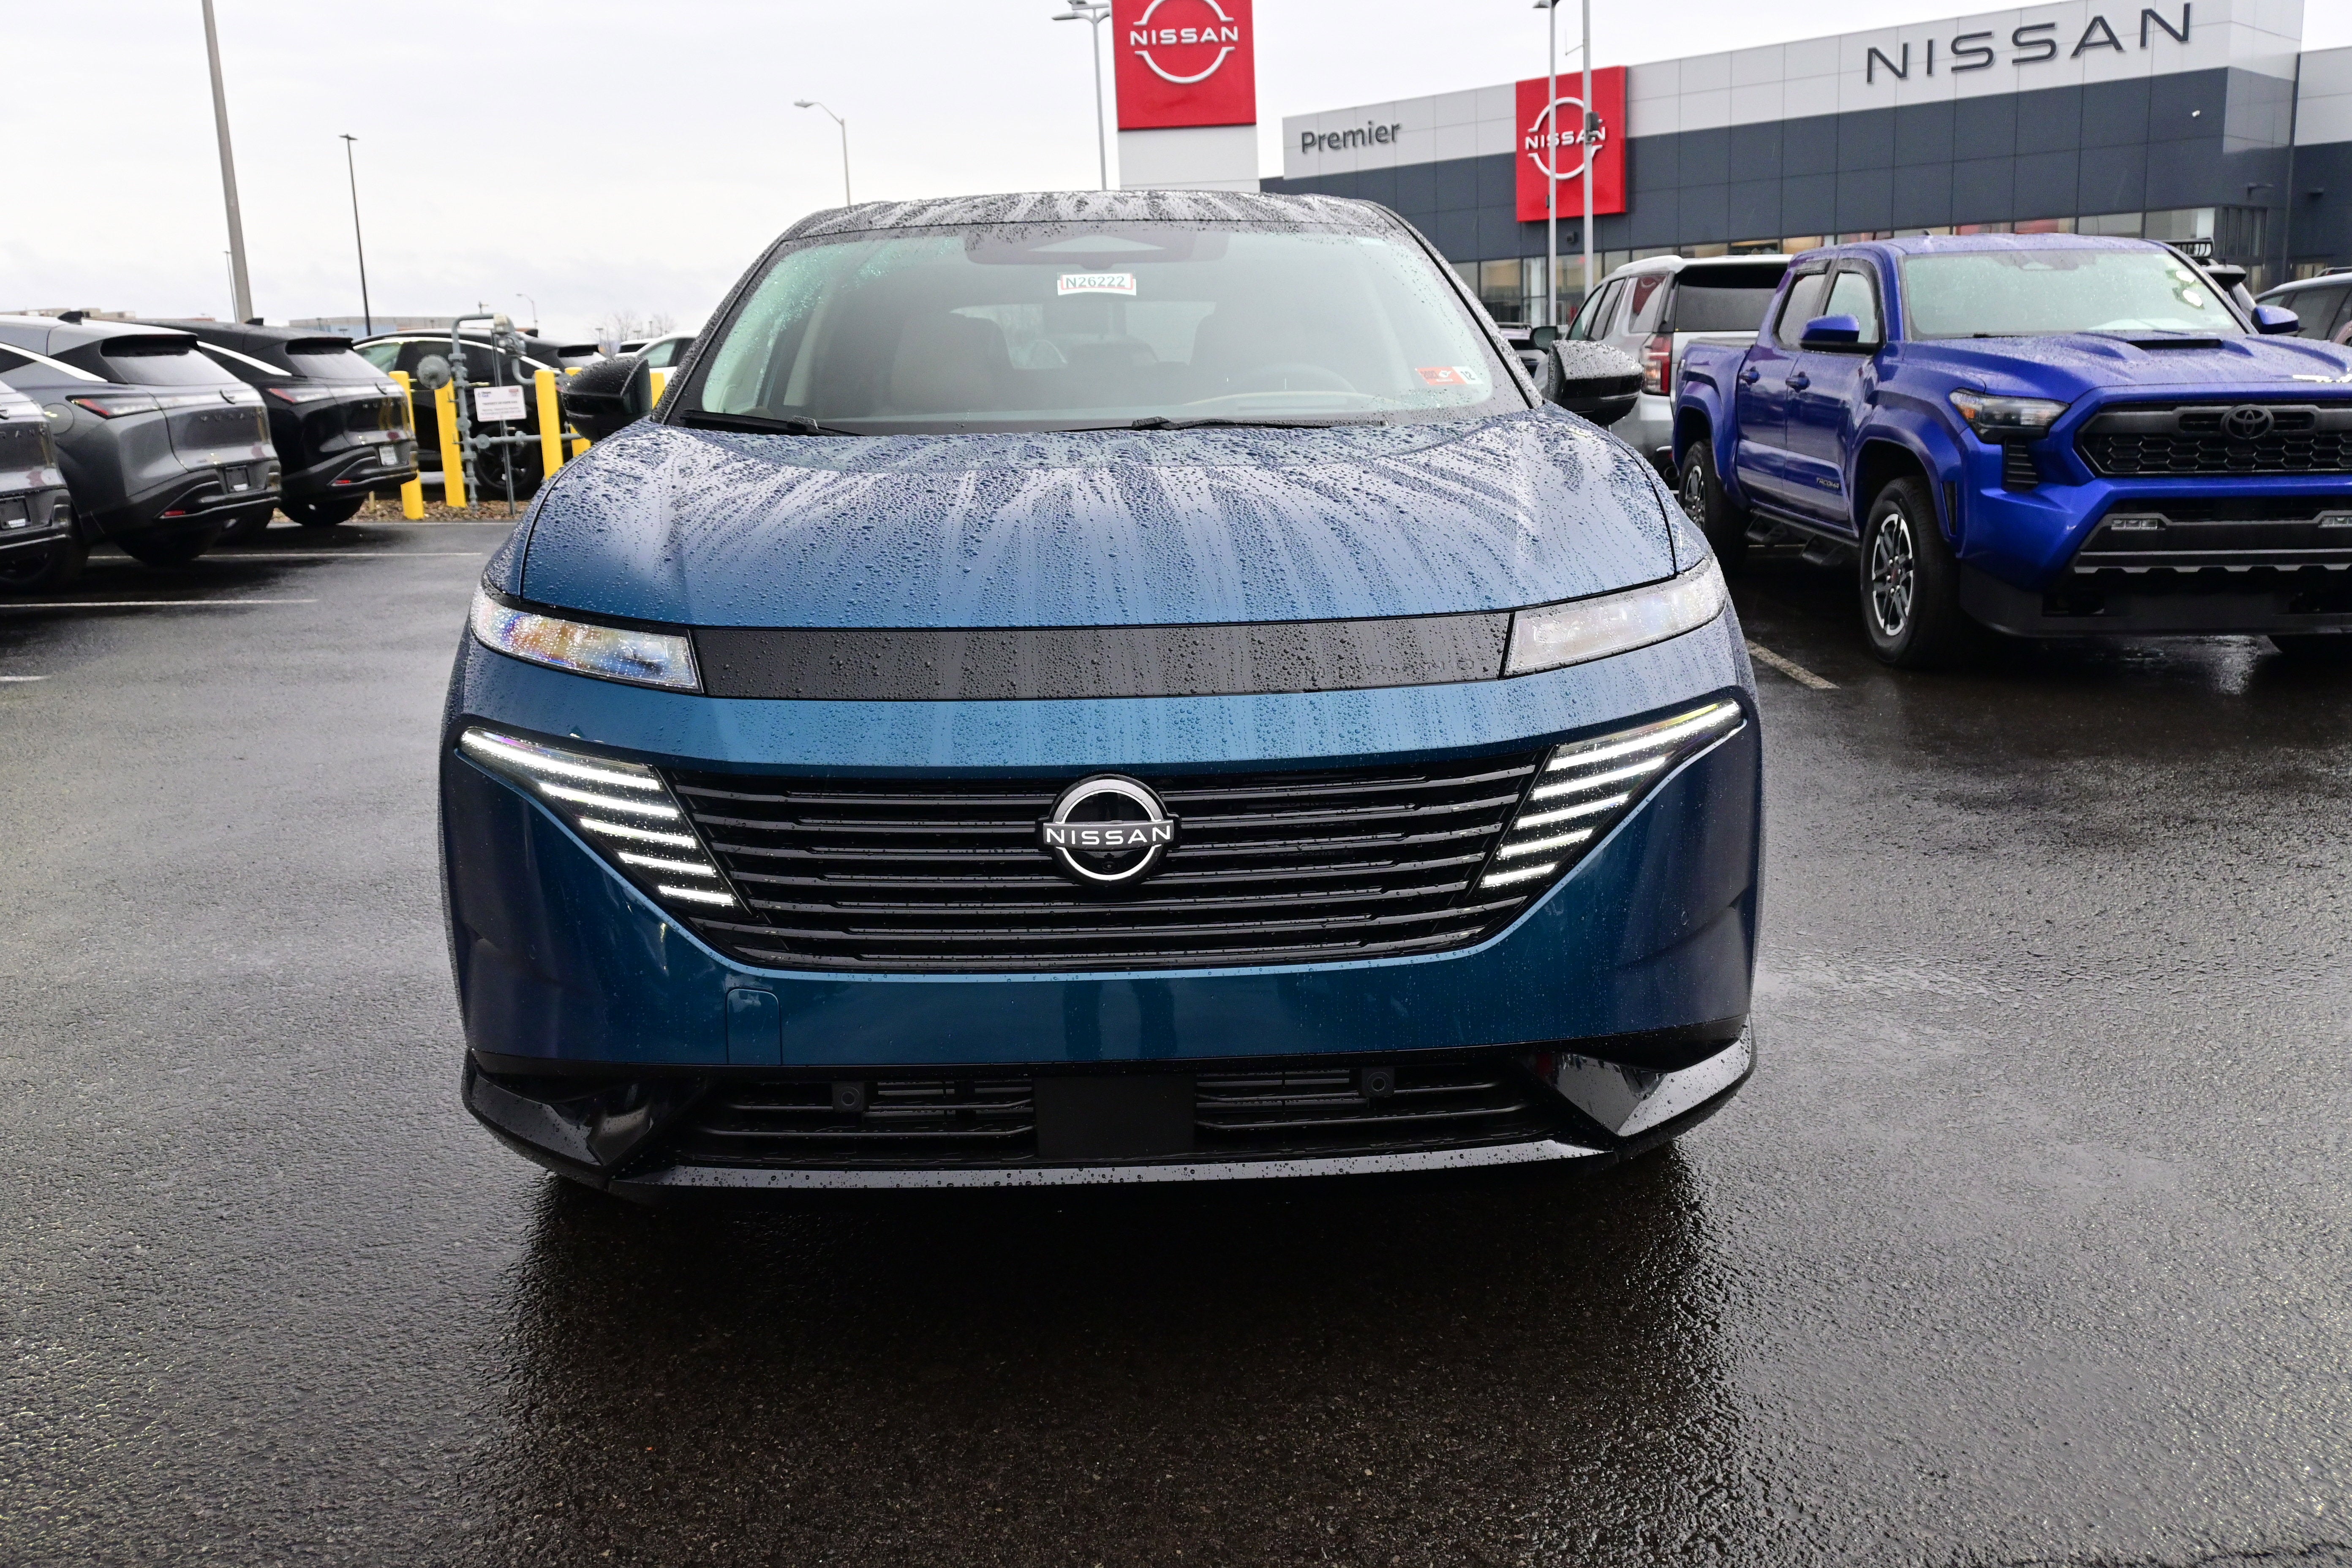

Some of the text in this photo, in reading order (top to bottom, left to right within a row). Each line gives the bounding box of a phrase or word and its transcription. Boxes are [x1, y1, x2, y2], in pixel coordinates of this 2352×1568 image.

[1130, 26, 1239, 46] NISSAN
[1867, 2, 2191, 84] NISSAN
[1301, 120, 1401, 153] Premier
[1066, 276, 1125, 288] N26222
[1460, 371, 1476, 380] 12
[1816, 477, 1839, 488] TACOMA
[1046, 825, 1171, 845] NISSAN
